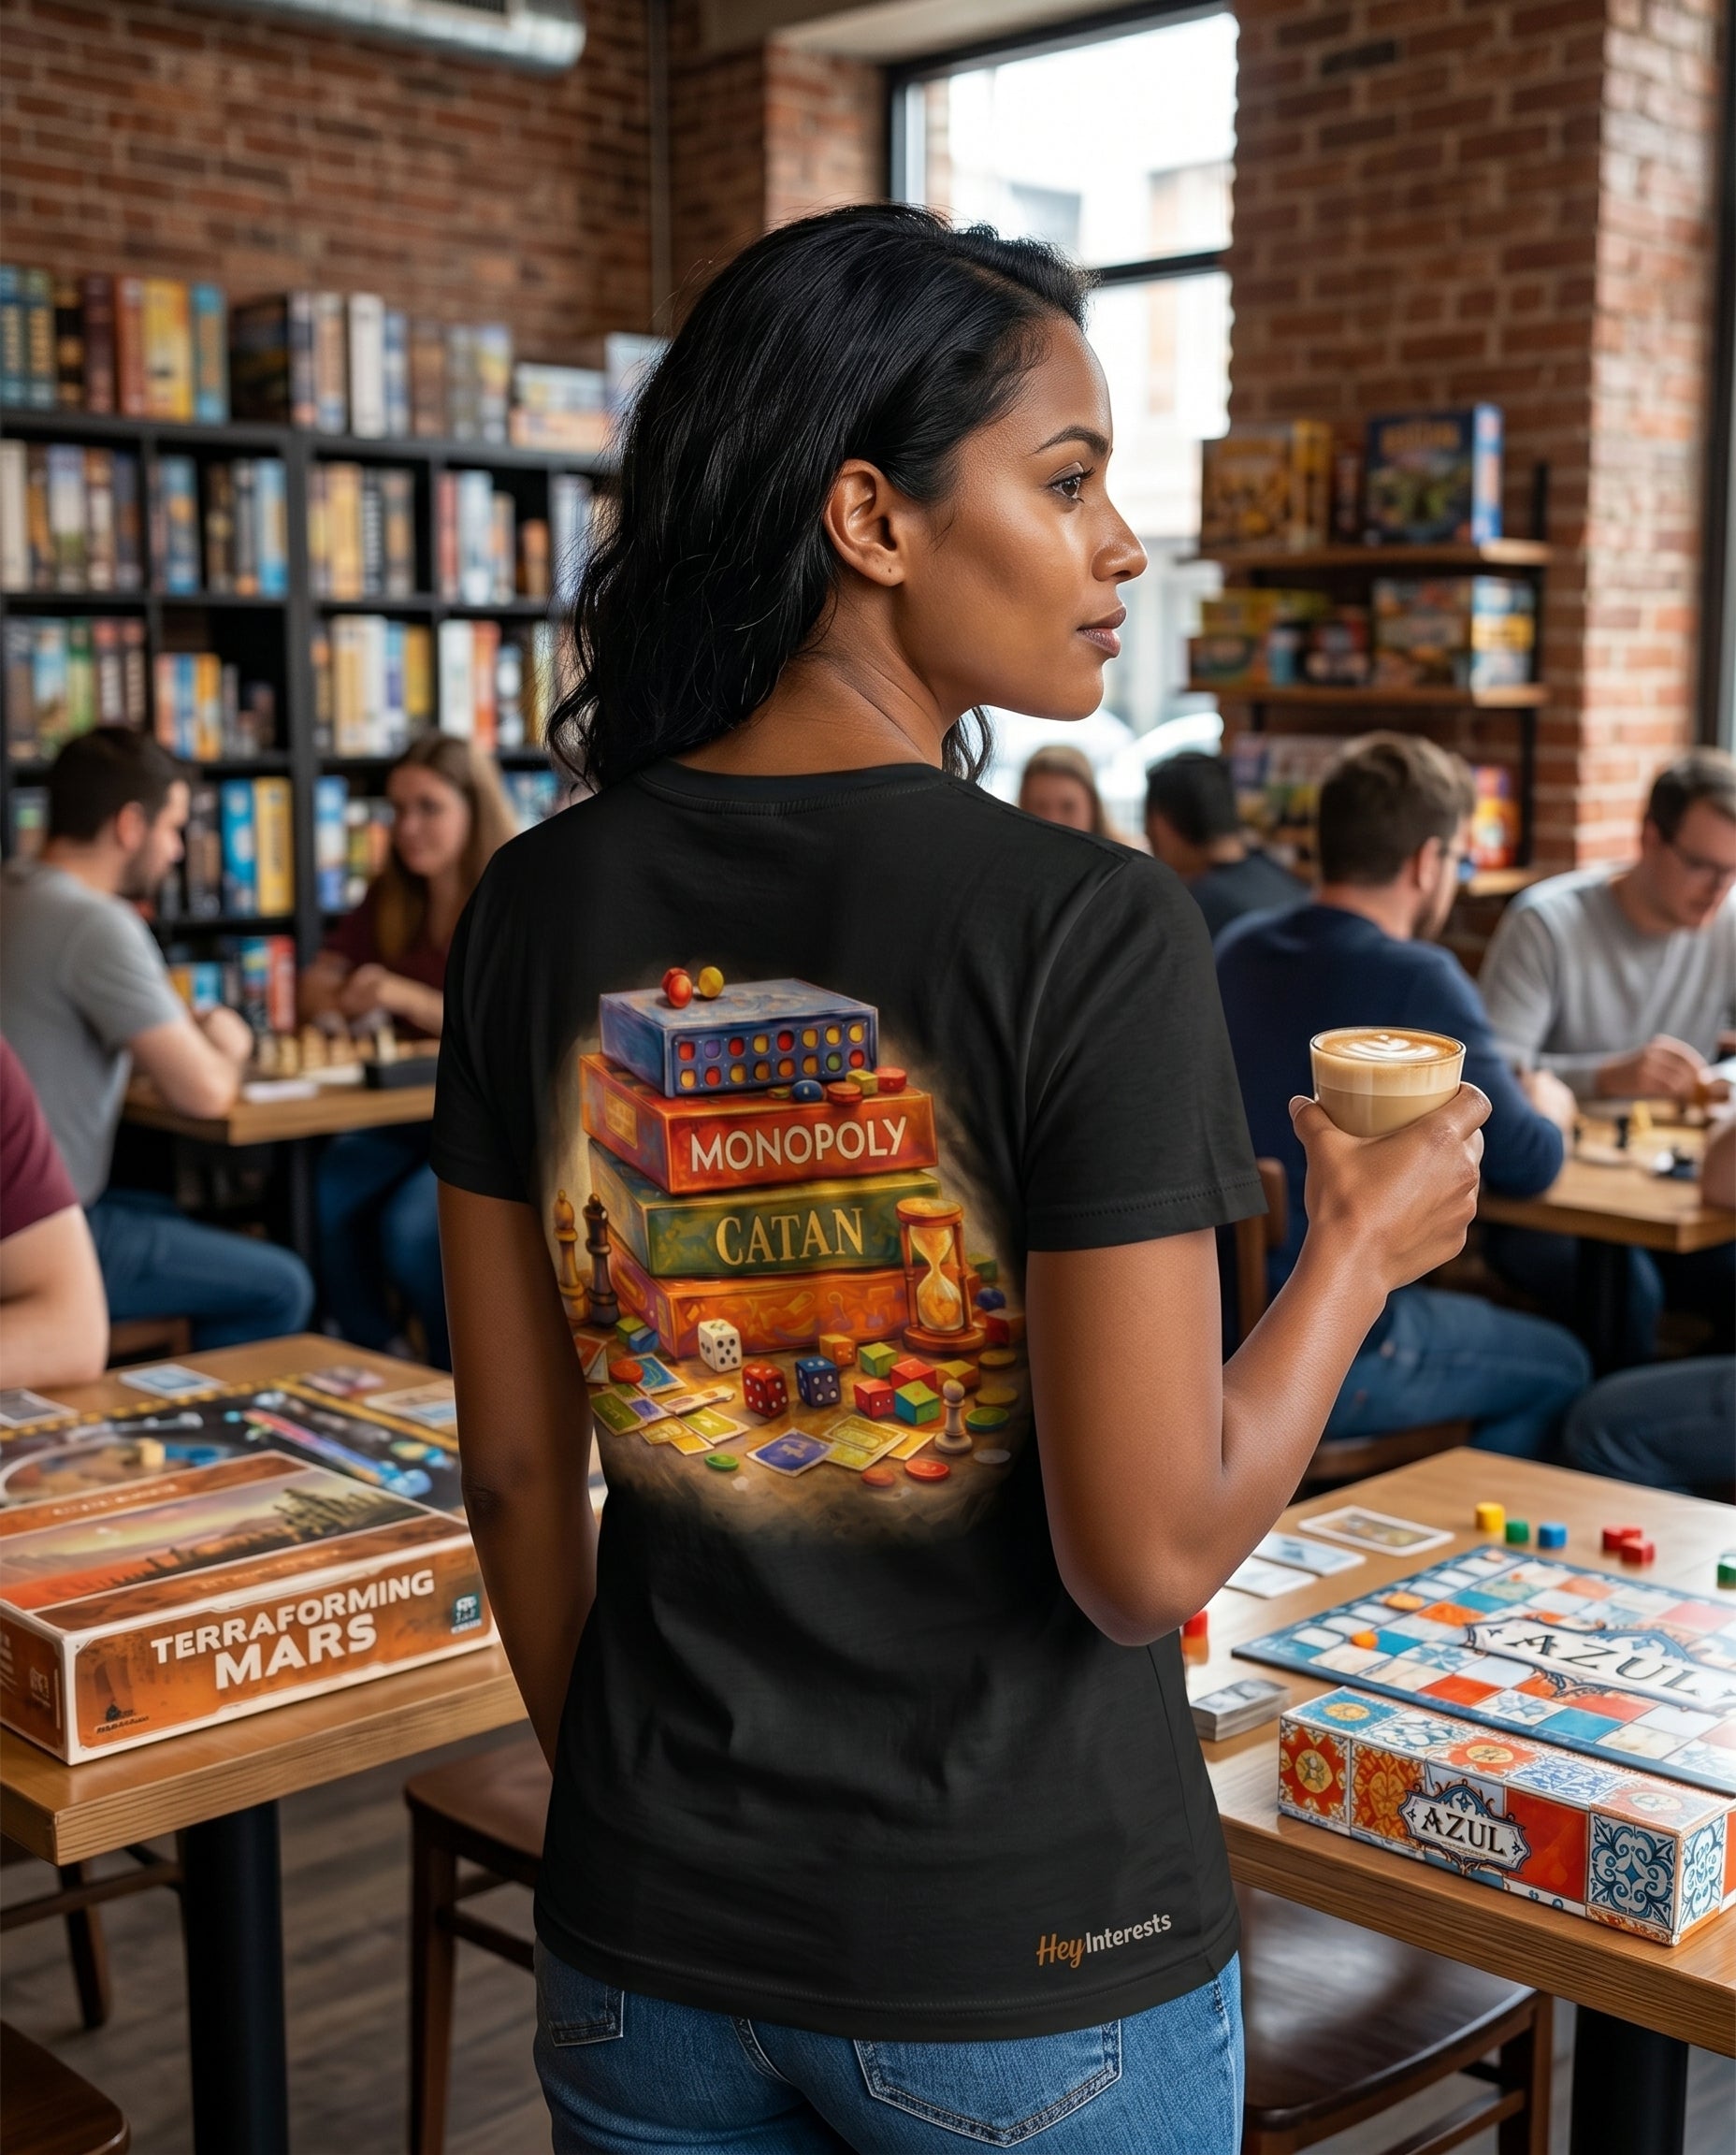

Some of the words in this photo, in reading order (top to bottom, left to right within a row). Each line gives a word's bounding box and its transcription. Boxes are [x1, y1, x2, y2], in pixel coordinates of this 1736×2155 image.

[690, 1116, 907, 1173] MONOPOLY
[715, 1207, 864, 1266] CATAN
[151, 1569, 435, 1665] TERRAFORMING
[215, 1613, 377, 1690] MARS
[1504, 1634, 1700, 1697] AZUL
[1421, 1806, 1508, 1857] AZUL
[1035, 1914, 1172, 1969] HeyInterests
